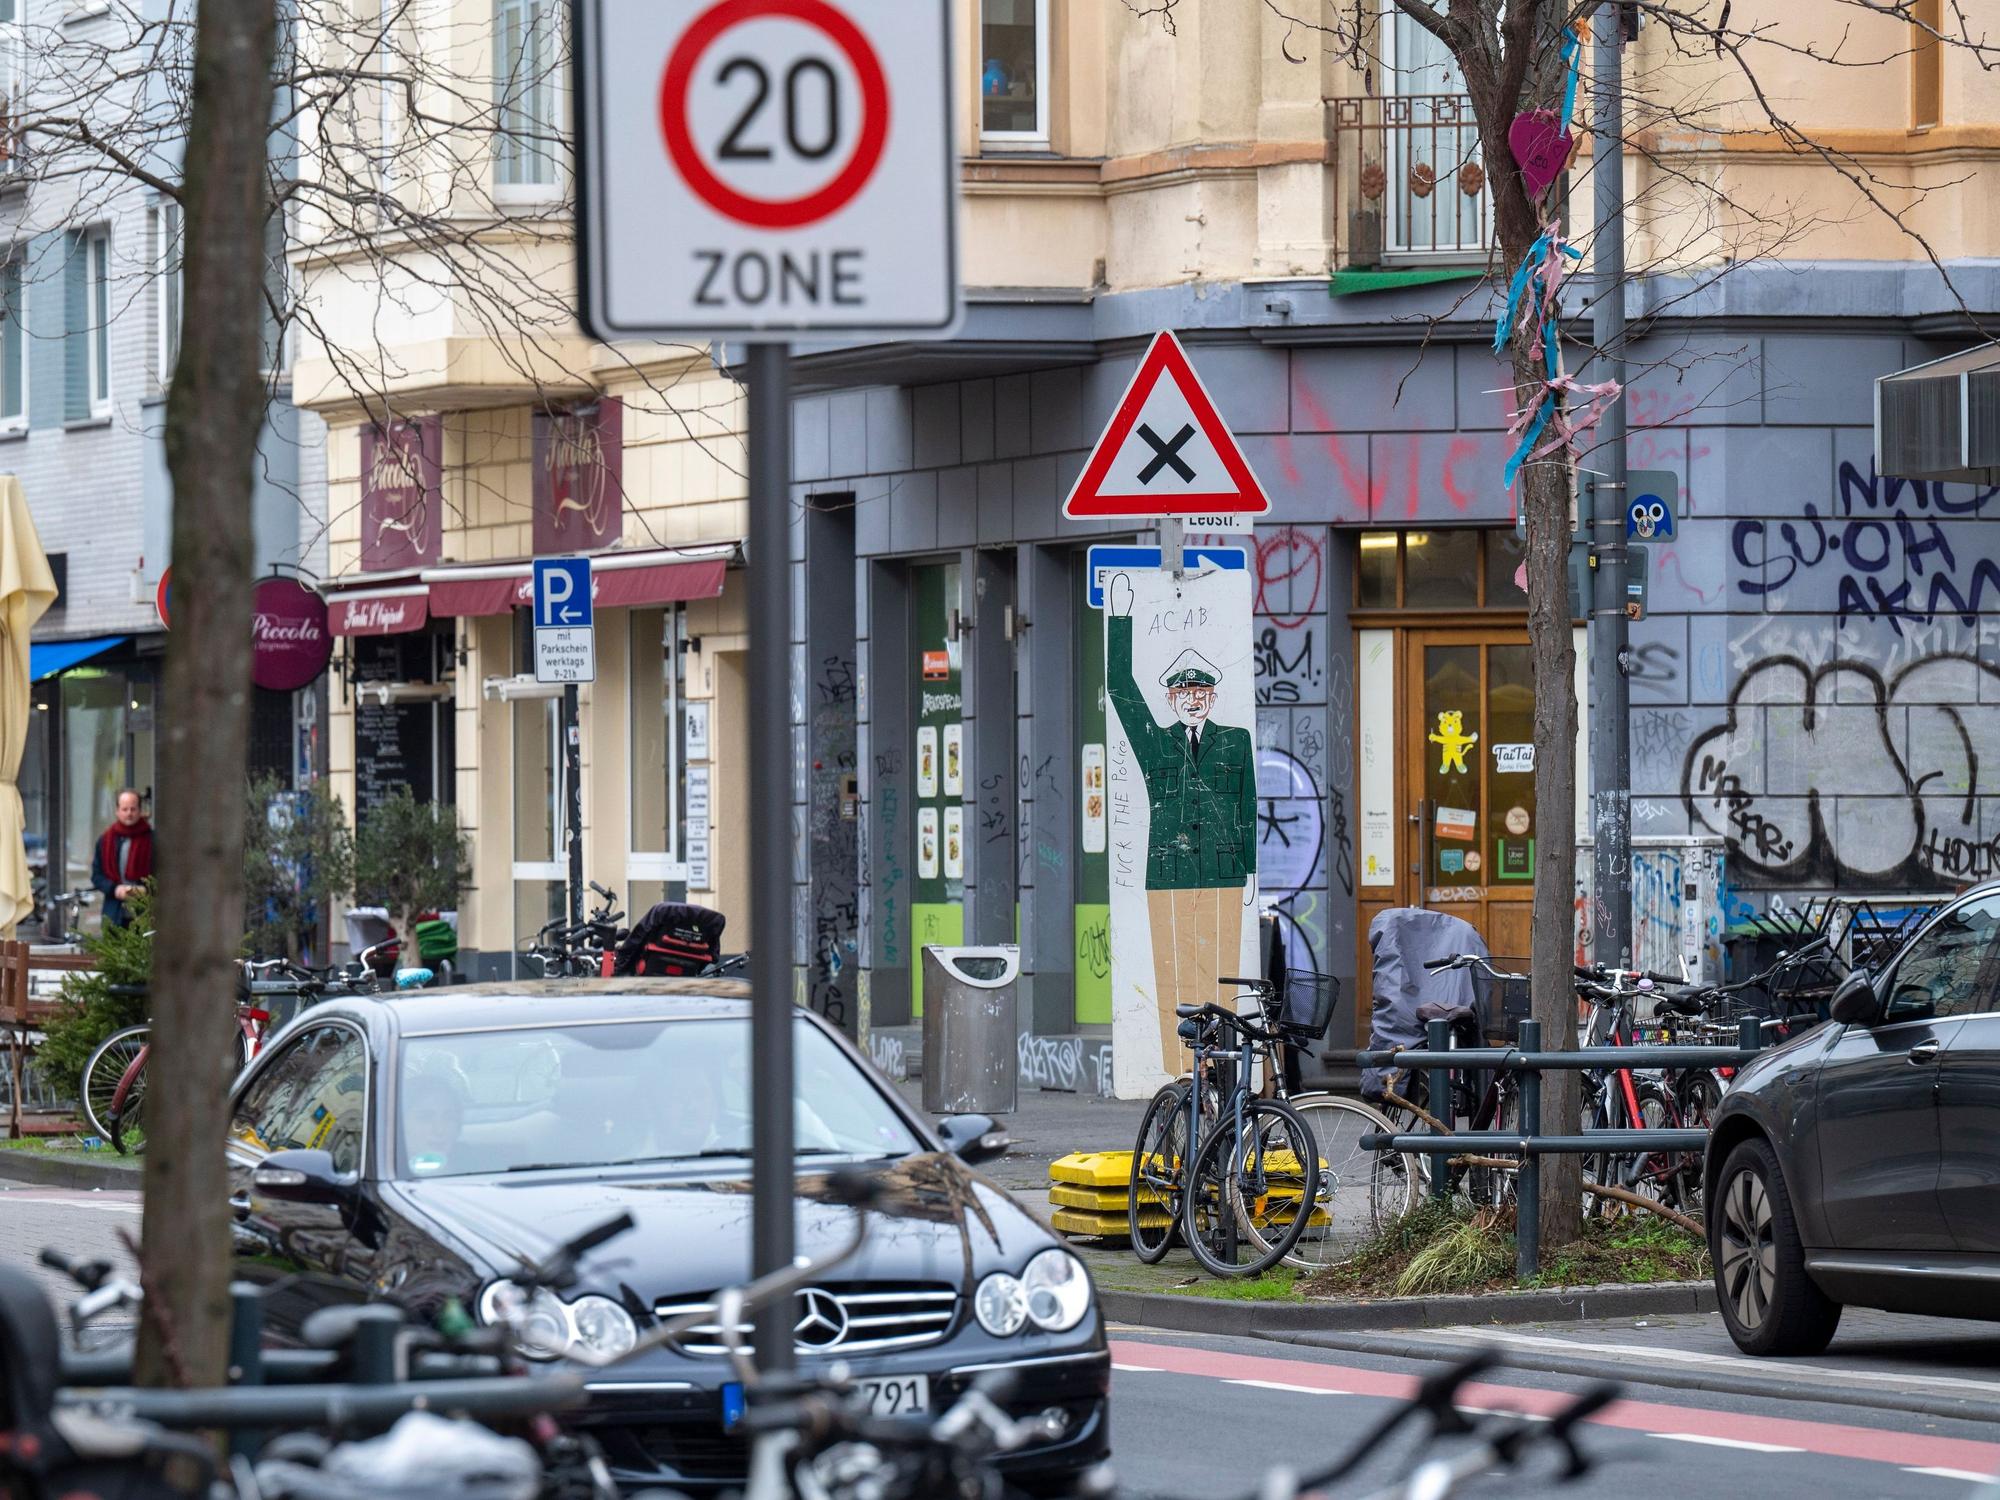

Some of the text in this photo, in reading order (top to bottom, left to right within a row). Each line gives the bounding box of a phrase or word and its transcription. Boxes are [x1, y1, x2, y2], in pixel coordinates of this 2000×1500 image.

[716, 54, 840, 161] 20
[693, 251, 864, 306] ZONE
[543, 568, 573, 625] P
[252, 614, 320, 640] Piccola
[1149, 607, 1208, 636] ACAB
[541, 643, 588, 654] Parkschein
[557, 632, 571, 641] mit
[545, 657, 585, 669] werktags
[554, 669, 577, 679] 9-21h
[1114, 792, 1130, 825] THE
